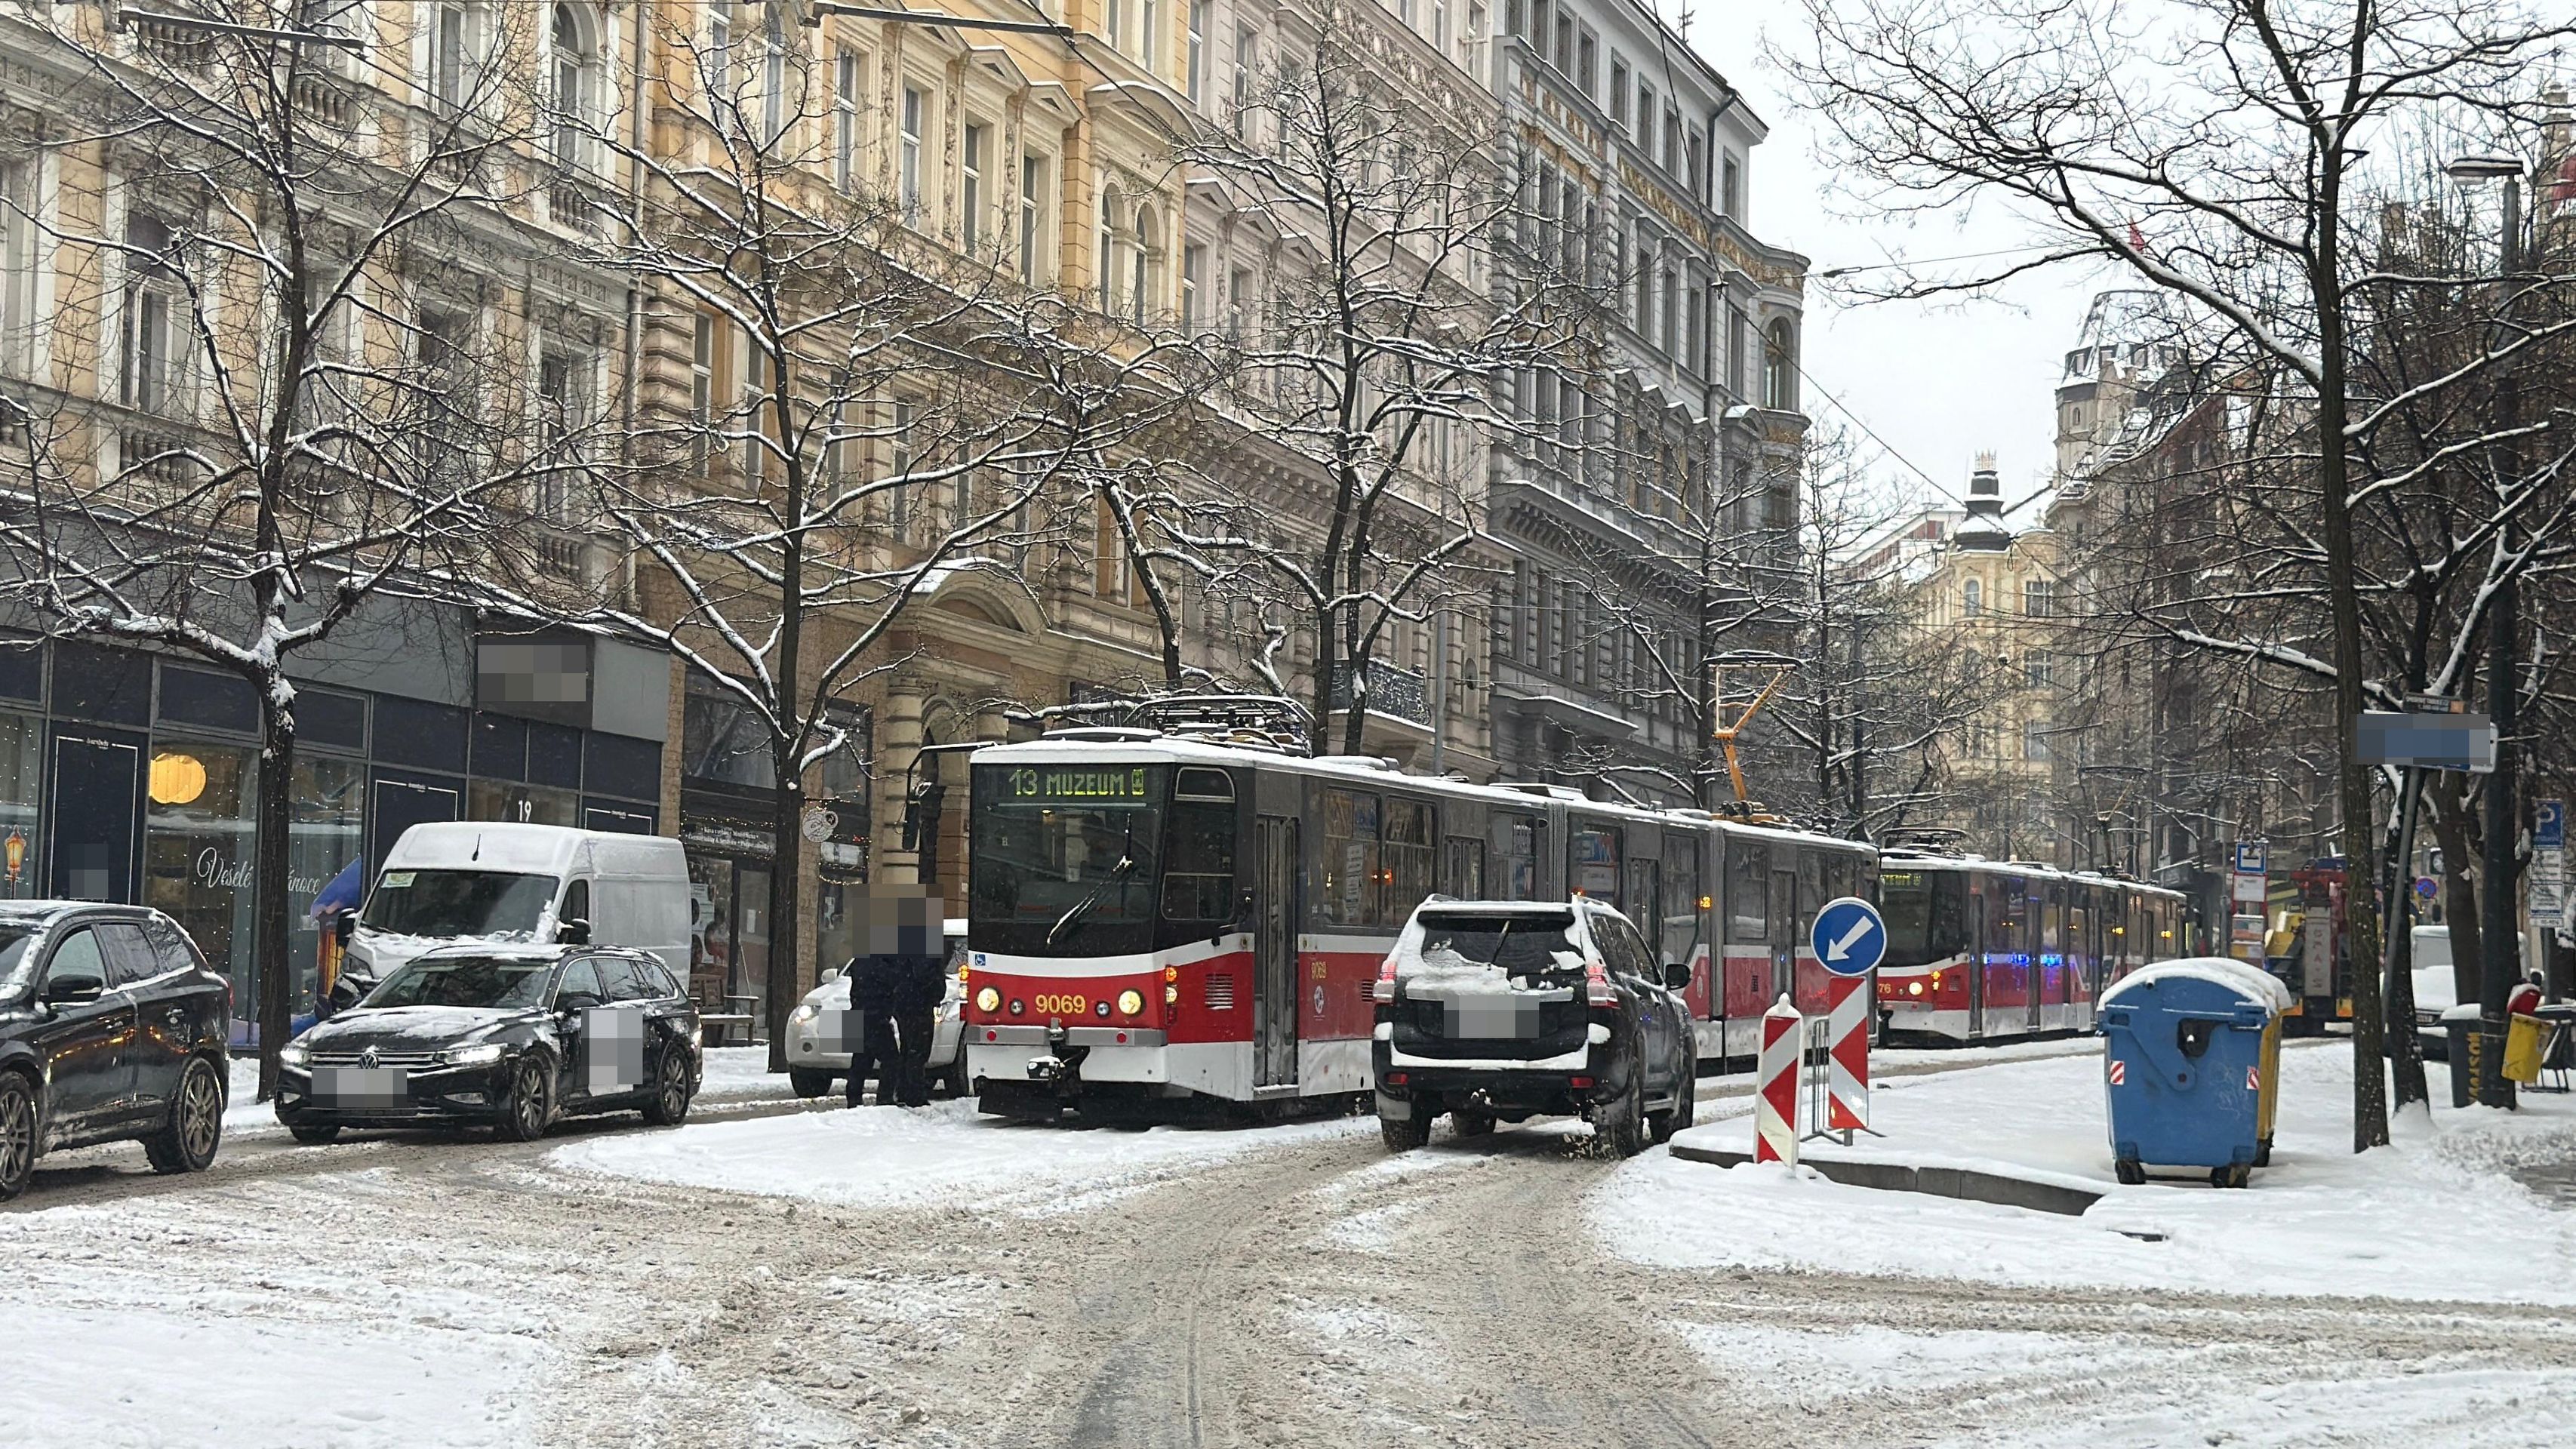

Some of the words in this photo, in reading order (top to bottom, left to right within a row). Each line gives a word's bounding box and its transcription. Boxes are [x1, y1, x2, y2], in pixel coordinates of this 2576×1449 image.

[1008, 769, 1038, 795] 13
[1046, 774, 1125, 795] MUZEUM
[519, 800, 532, 823] 19
[197, 847, 254, 888] Veselé
[288, 869, 320, 894] ánoce
[1312, 961, 1327, 980] 9069
[1035, 994, 1086, 1014] 9069
